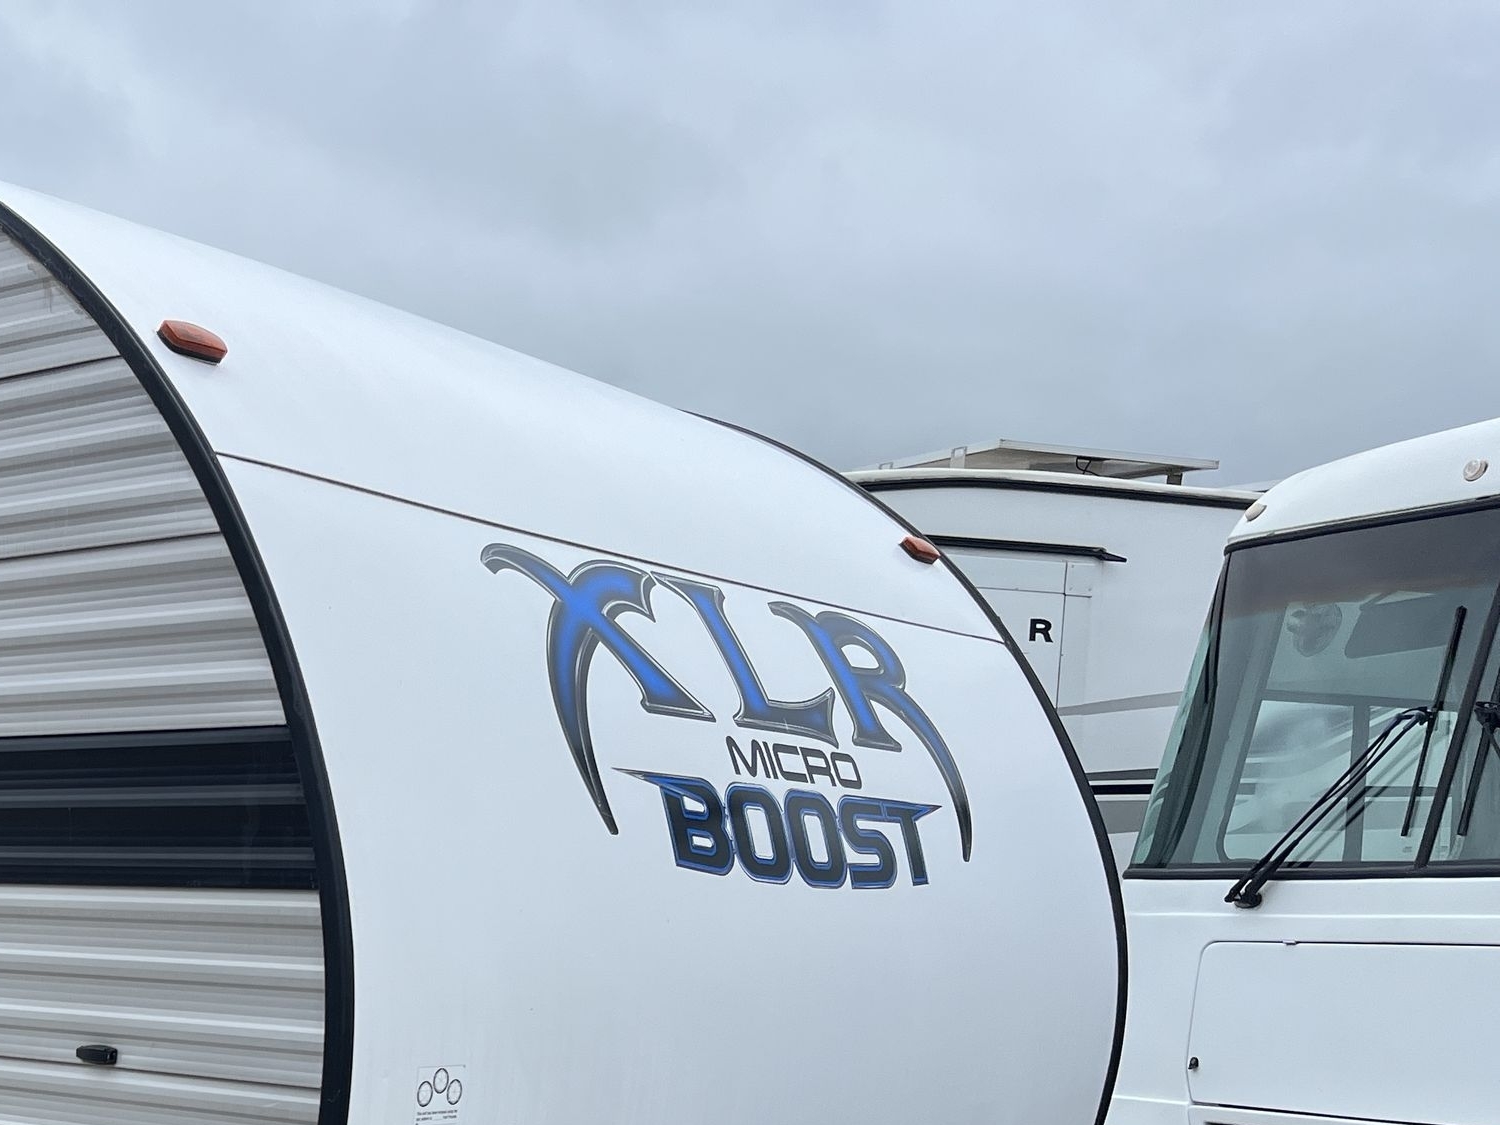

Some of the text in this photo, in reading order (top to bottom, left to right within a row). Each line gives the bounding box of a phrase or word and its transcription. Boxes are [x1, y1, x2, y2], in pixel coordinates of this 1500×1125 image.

[1029, 618, 1053, 643] R
[480, 543, 972, 863] XLR
[725, 735, 862, 789] MICRO
[612, 767, 941, 890] BOOST
